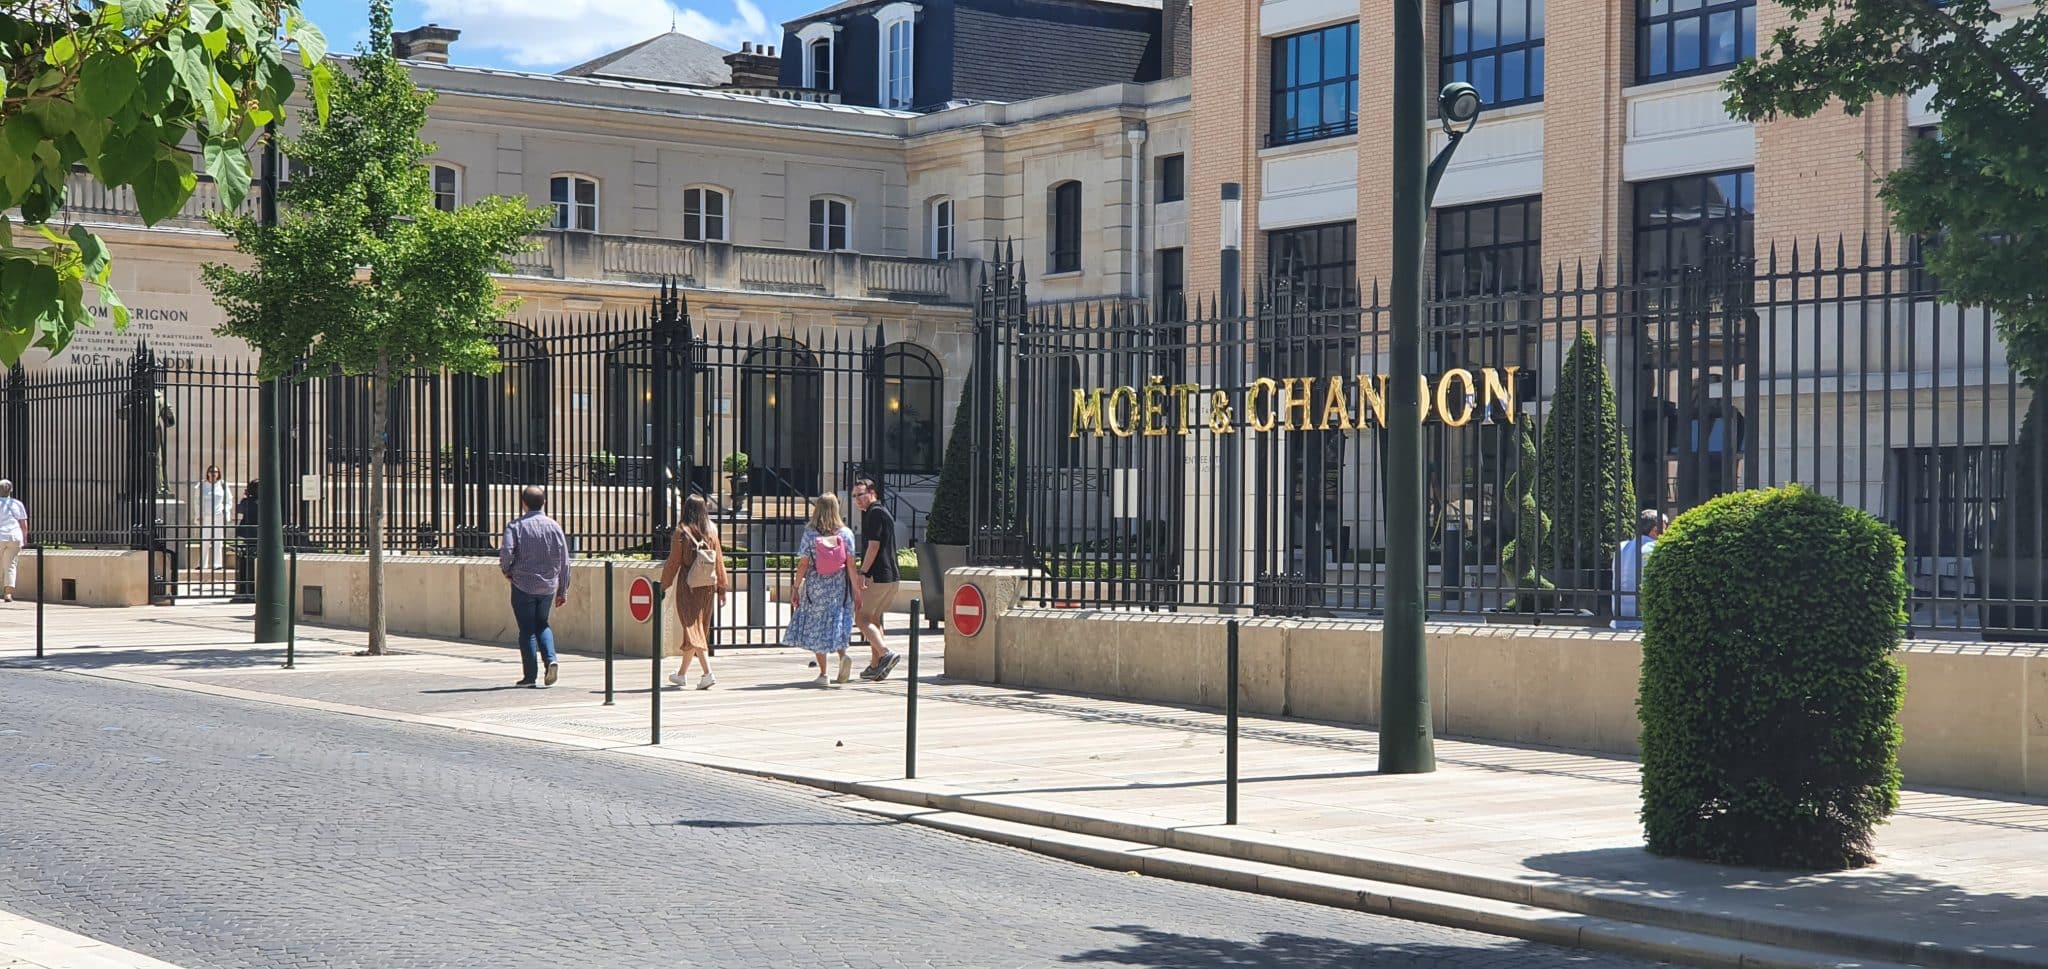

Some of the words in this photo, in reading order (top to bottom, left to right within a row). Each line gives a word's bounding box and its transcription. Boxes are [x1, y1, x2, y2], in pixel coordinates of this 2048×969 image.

[88, 306, 108, 318] OM
[127, 308, 188, 321] RIGNON
[1069, 375, 1199, 438] MOËT
[1209, 389, 1236, 434] &
